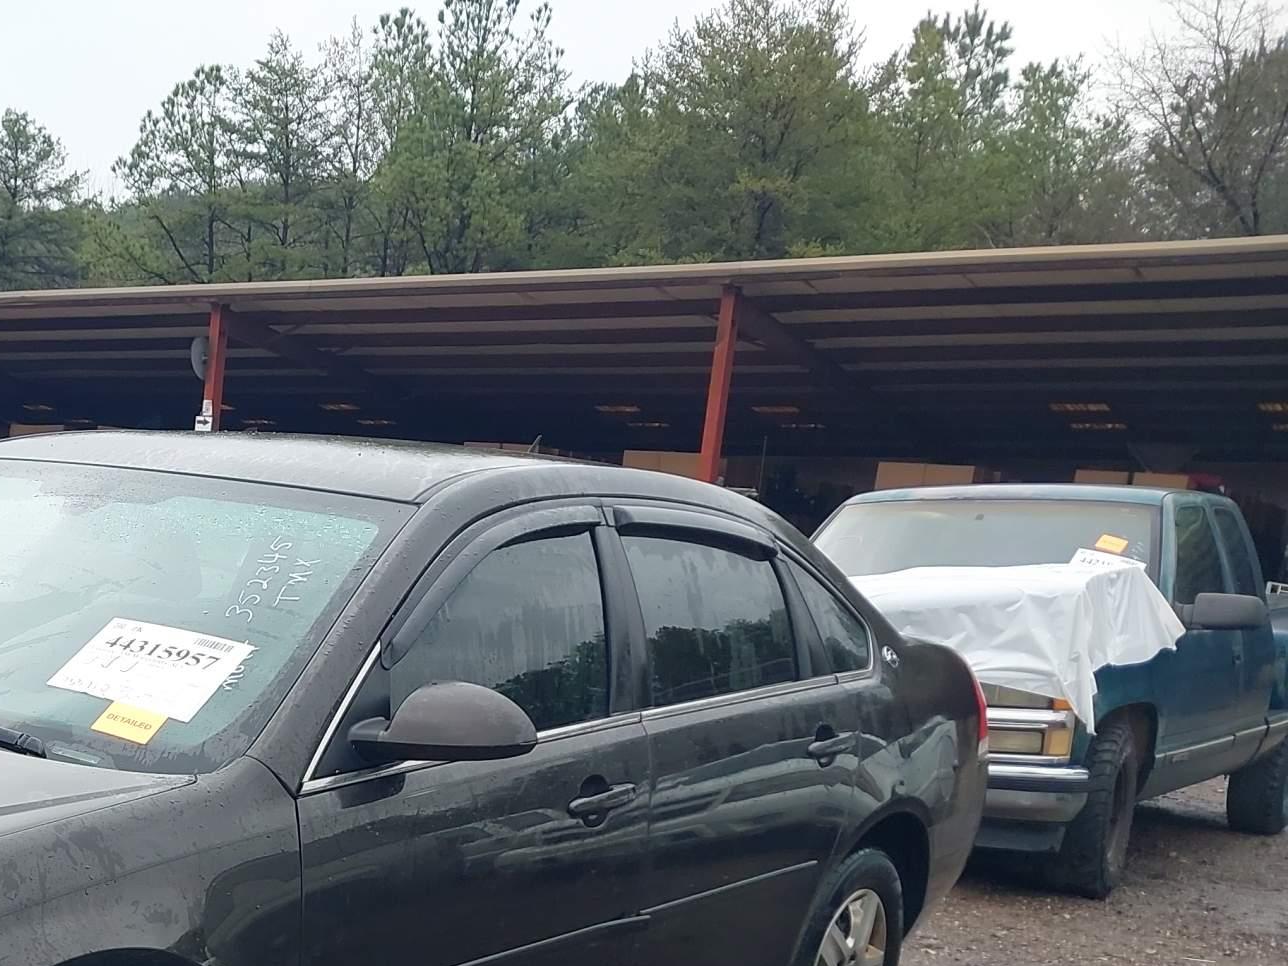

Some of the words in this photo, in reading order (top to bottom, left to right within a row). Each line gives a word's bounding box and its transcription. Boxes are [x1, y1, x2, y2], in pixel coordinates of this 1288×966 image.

[225, 535, 293, 623] 352345
[105, 635, 222, 670] 44315957
[105, 712, 153, 731] DETAILED
